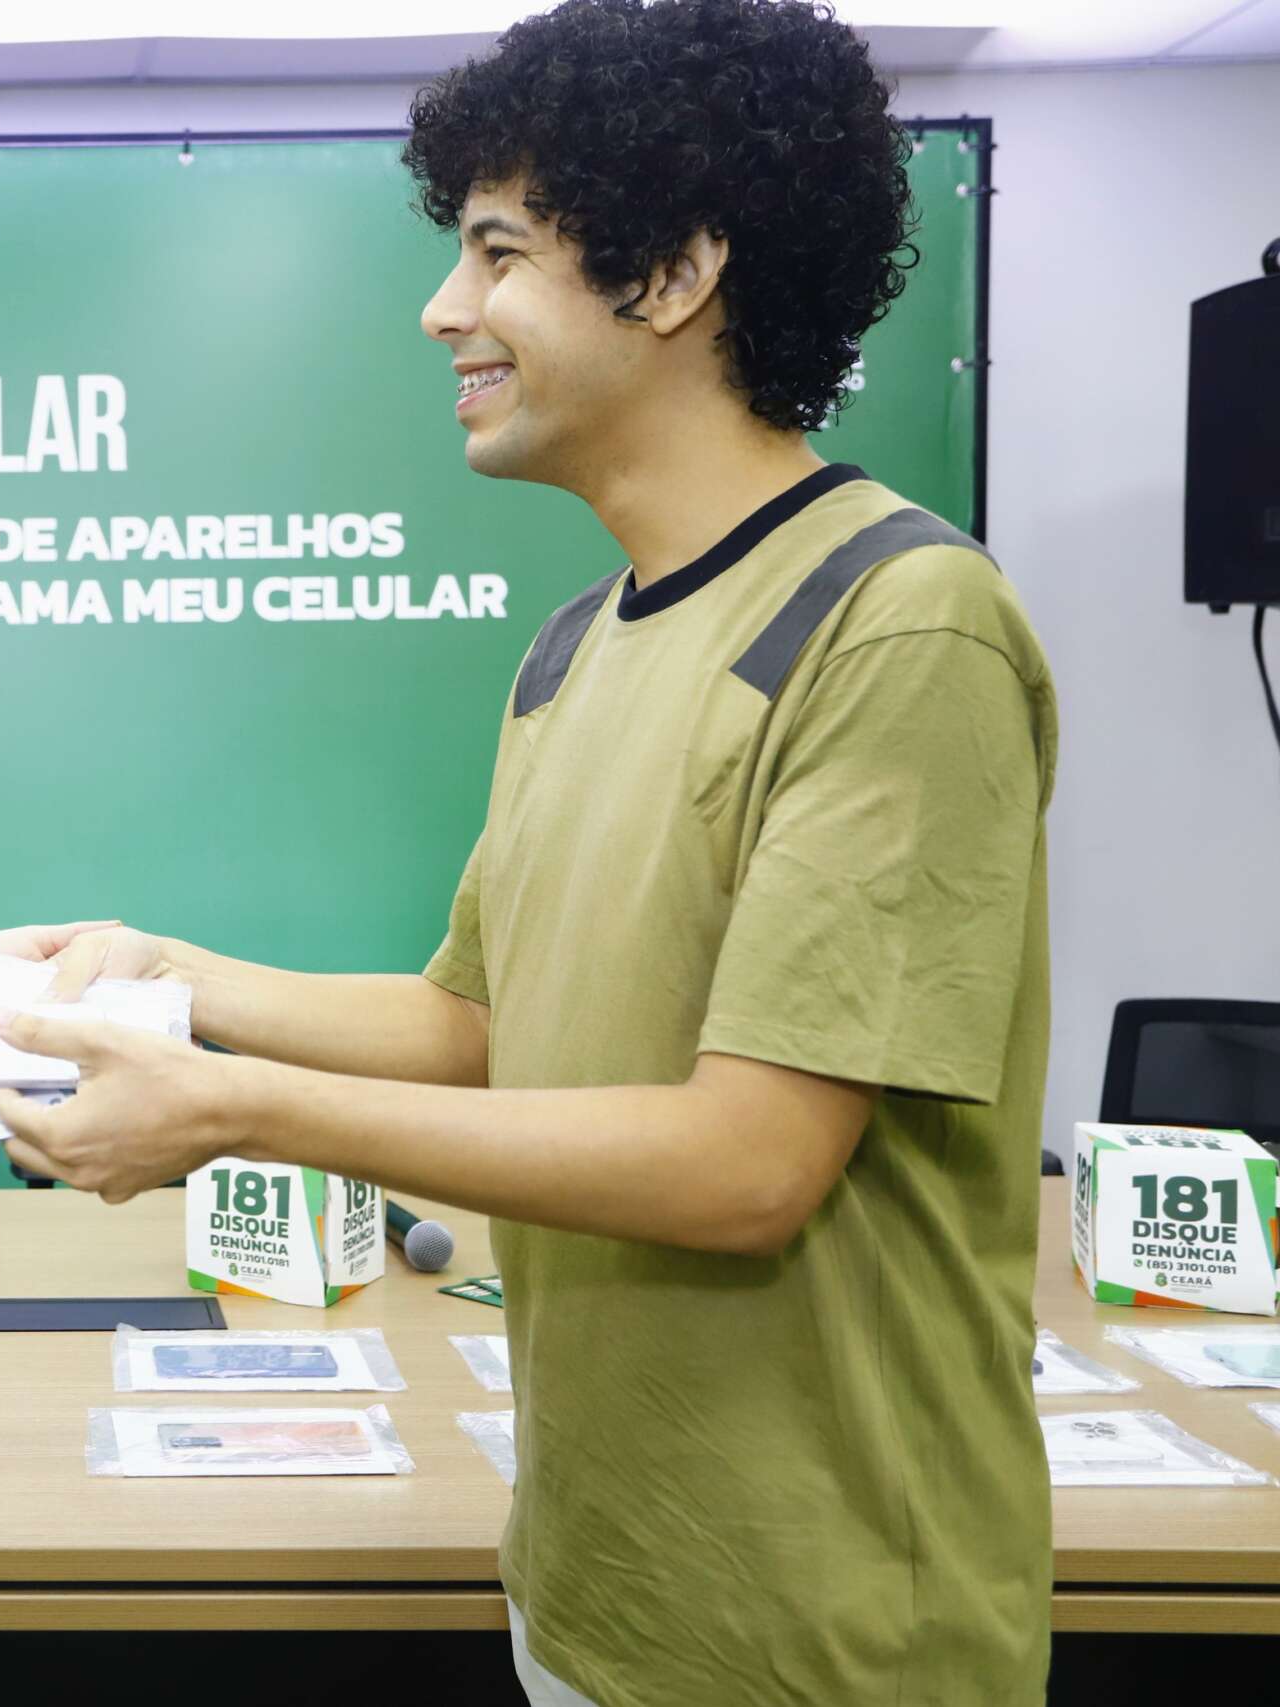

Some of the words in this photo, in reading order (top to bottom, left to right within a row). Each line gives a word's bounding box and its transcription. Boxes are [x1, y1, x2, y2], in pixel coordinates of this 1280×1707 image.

[66, 512, 405, 561] APARELHOS
[122, 577, 244, 623] MEU
[252, 574, 508, 622] CELULAR
[211, 1169, 290, 1220] 181
[1132, 1174, 1238, 1224] 181
[210, 1213, 289, 1239] DISQUE
[1133, 1220, 1237, 1246] DISQUE
[210, 1234, 289, 1256] DENÚNCIA
[221, 1251, 242, 1261] (85)
[1132, 1242, 1236, 1262] DENÚNCIA
[1147, 1260, 1174, 1271] (85)
[1176, 1262, 1237, 1275] 3101.0181
[1171, 1275, 1213, 1286] CEARÁ
